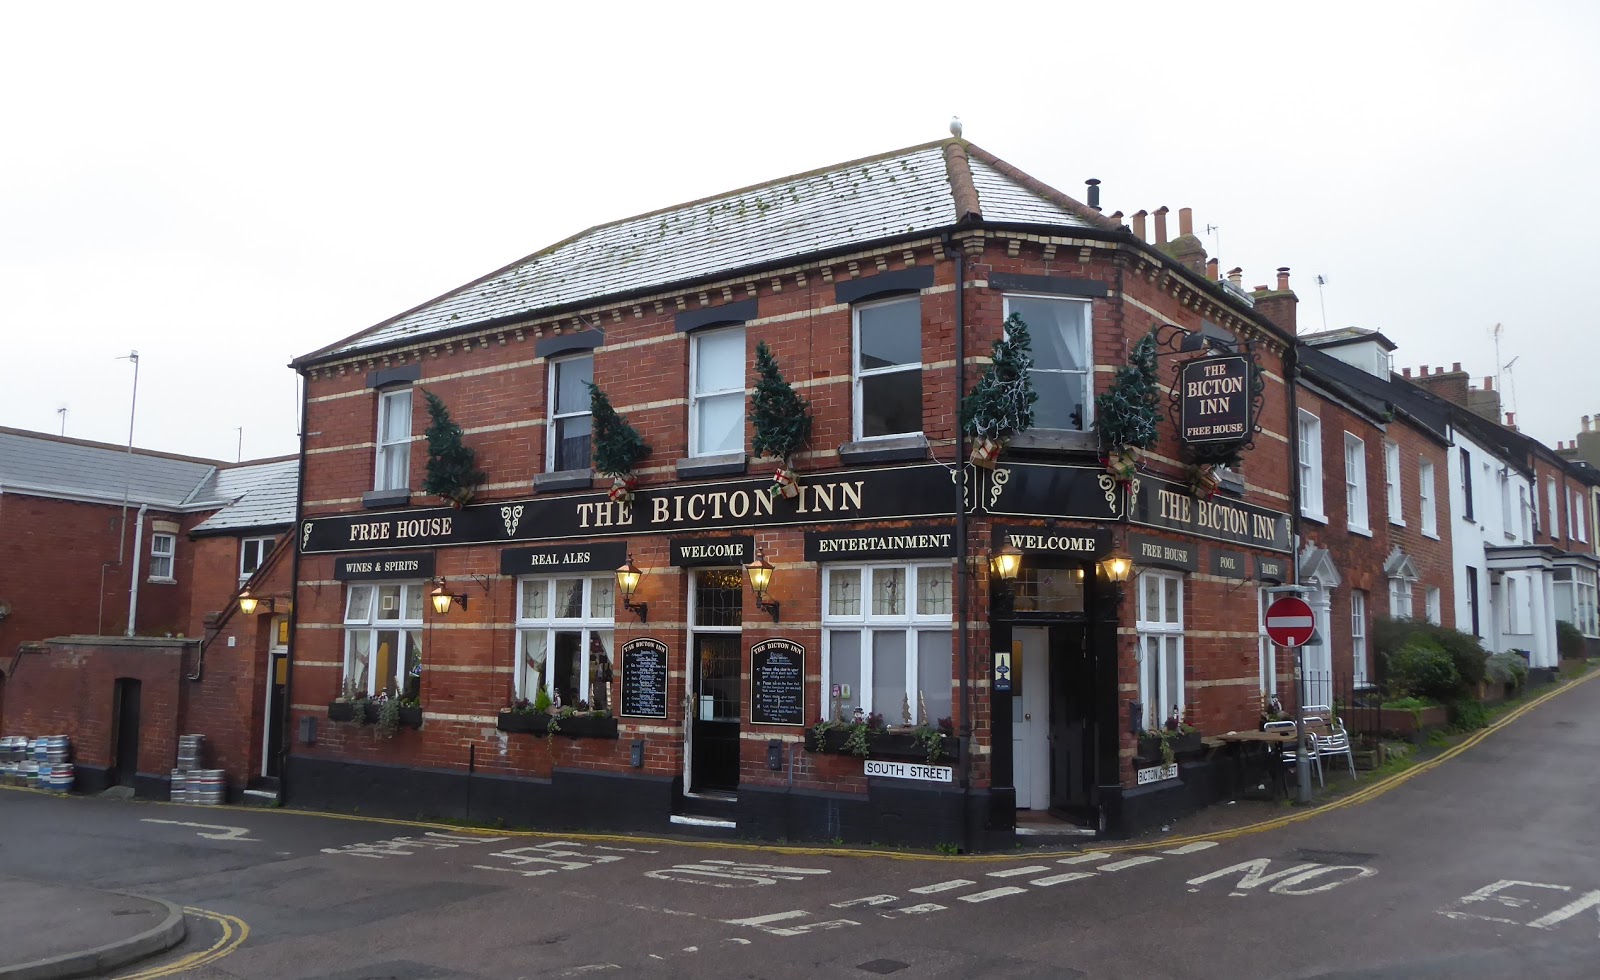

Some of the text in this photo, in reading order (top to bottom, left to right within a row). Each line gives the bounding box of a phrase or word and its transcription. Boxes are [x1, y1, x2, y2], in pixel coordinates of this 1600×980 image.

[1204, 364, 1226, 377] THE
[1187, 376, 1243, 398] BICTON
[1200, 397, 1230, 415] INN
[1187, 423, 1243, 437] FREE HOUSE
[577, 481, 864, 528] THE BICTON INN
[1158, 489, 1275, 541] THE BICTON INN
[350, 517, 452, 541] FREE HOUSE
[680, 543, 744, 558] WELCOME
[819, 534, 951, 552] ENTERTAINMENT
[1009, 534, 1095, 551] WELCOME
[531, 552, 591, 565] REAL ALES
[1142, 543, 1188, 562] FREE HOUSE
[346, 560, 419, 573] WINES & SPIRITS
[1220, 556, 1236, 570] POOL
[1262, 563, 1279, 575] DARTS
[754, 642, 802, 655] THE BICTON INN
[867, 763, 950, 780] SOUTH STREET
[1139, 769, 1159, 783] BICTON
[1186, 858, 1379, 898] NO
